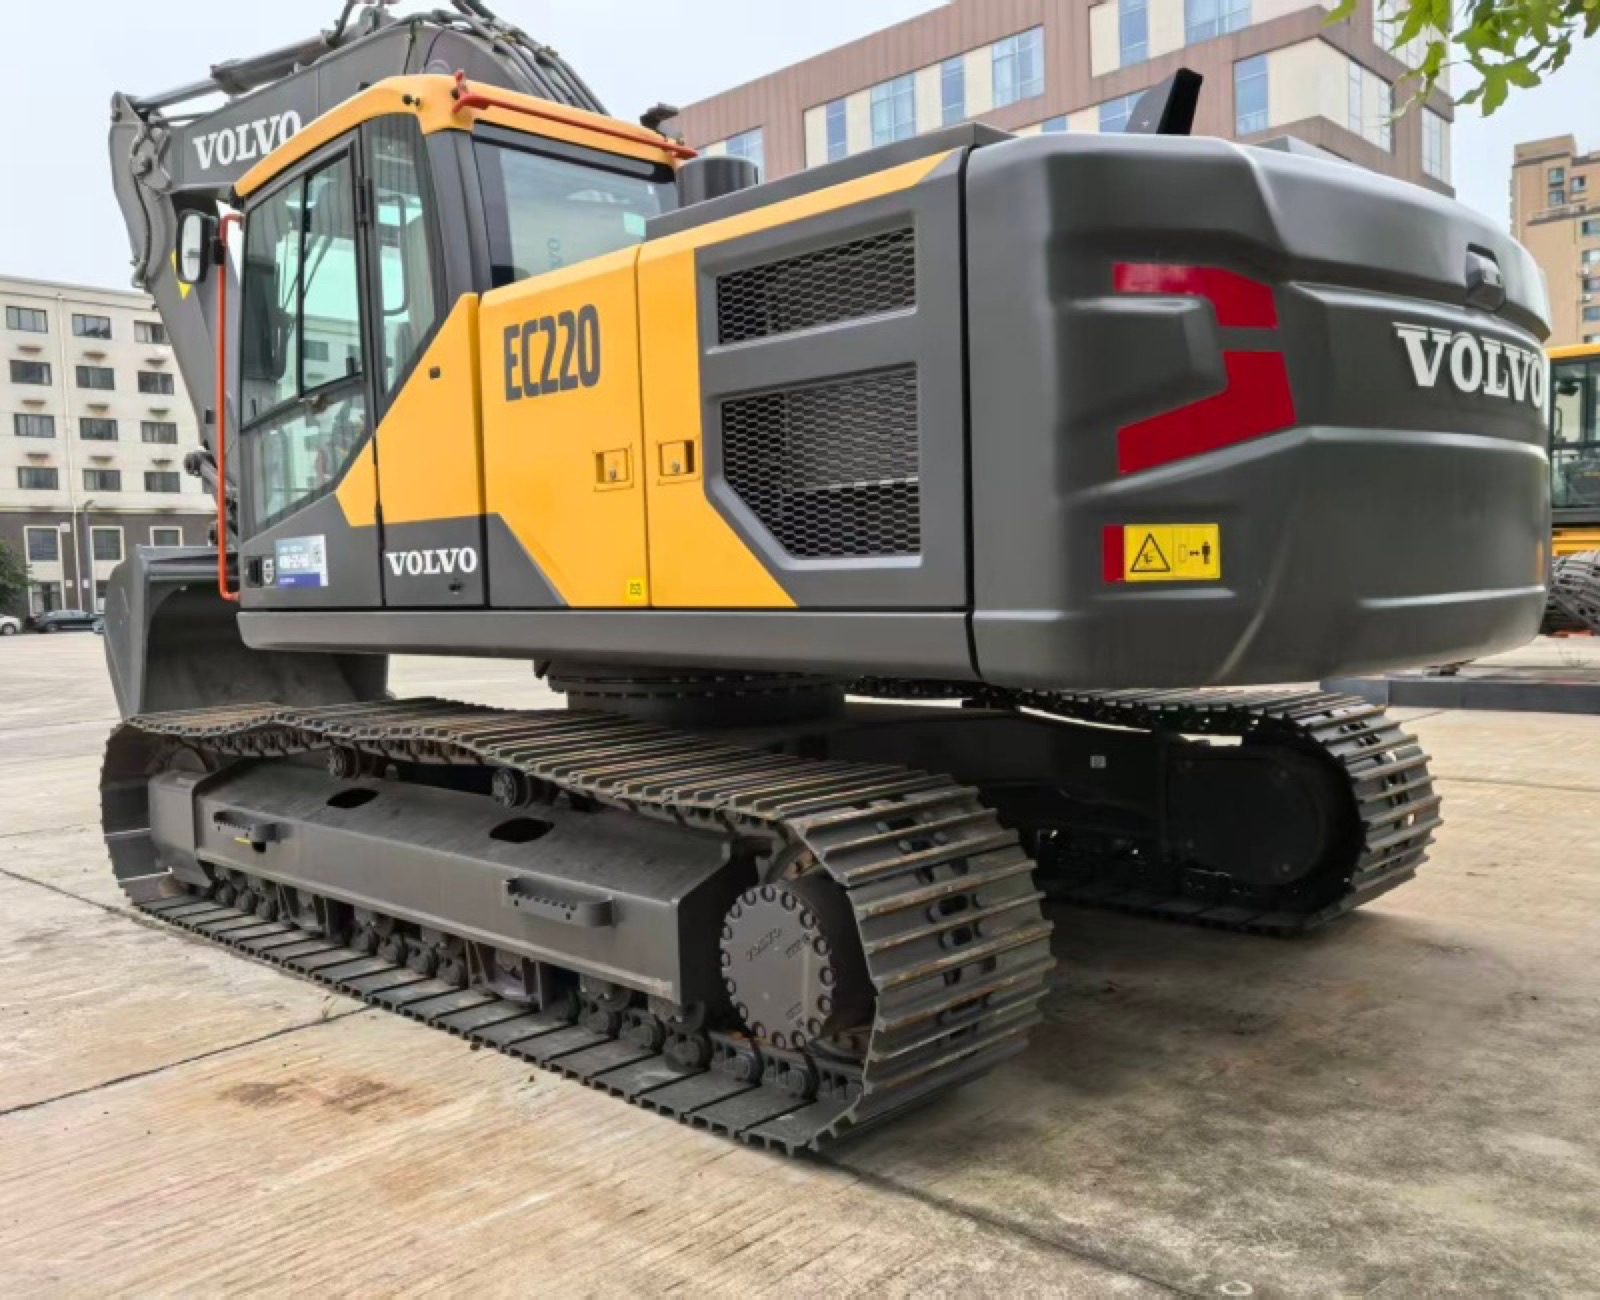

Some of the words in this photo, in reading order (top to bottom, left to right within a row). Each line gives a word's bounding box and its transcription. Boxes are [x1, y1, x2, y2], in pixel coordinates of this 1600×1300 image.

[192, 110, 302, 170] VOLVO
[503, 304, 600, 402] EC220
[1393, 322, 1543, 408] VOLVO
[385, 546, 478, 576] VOLVO
